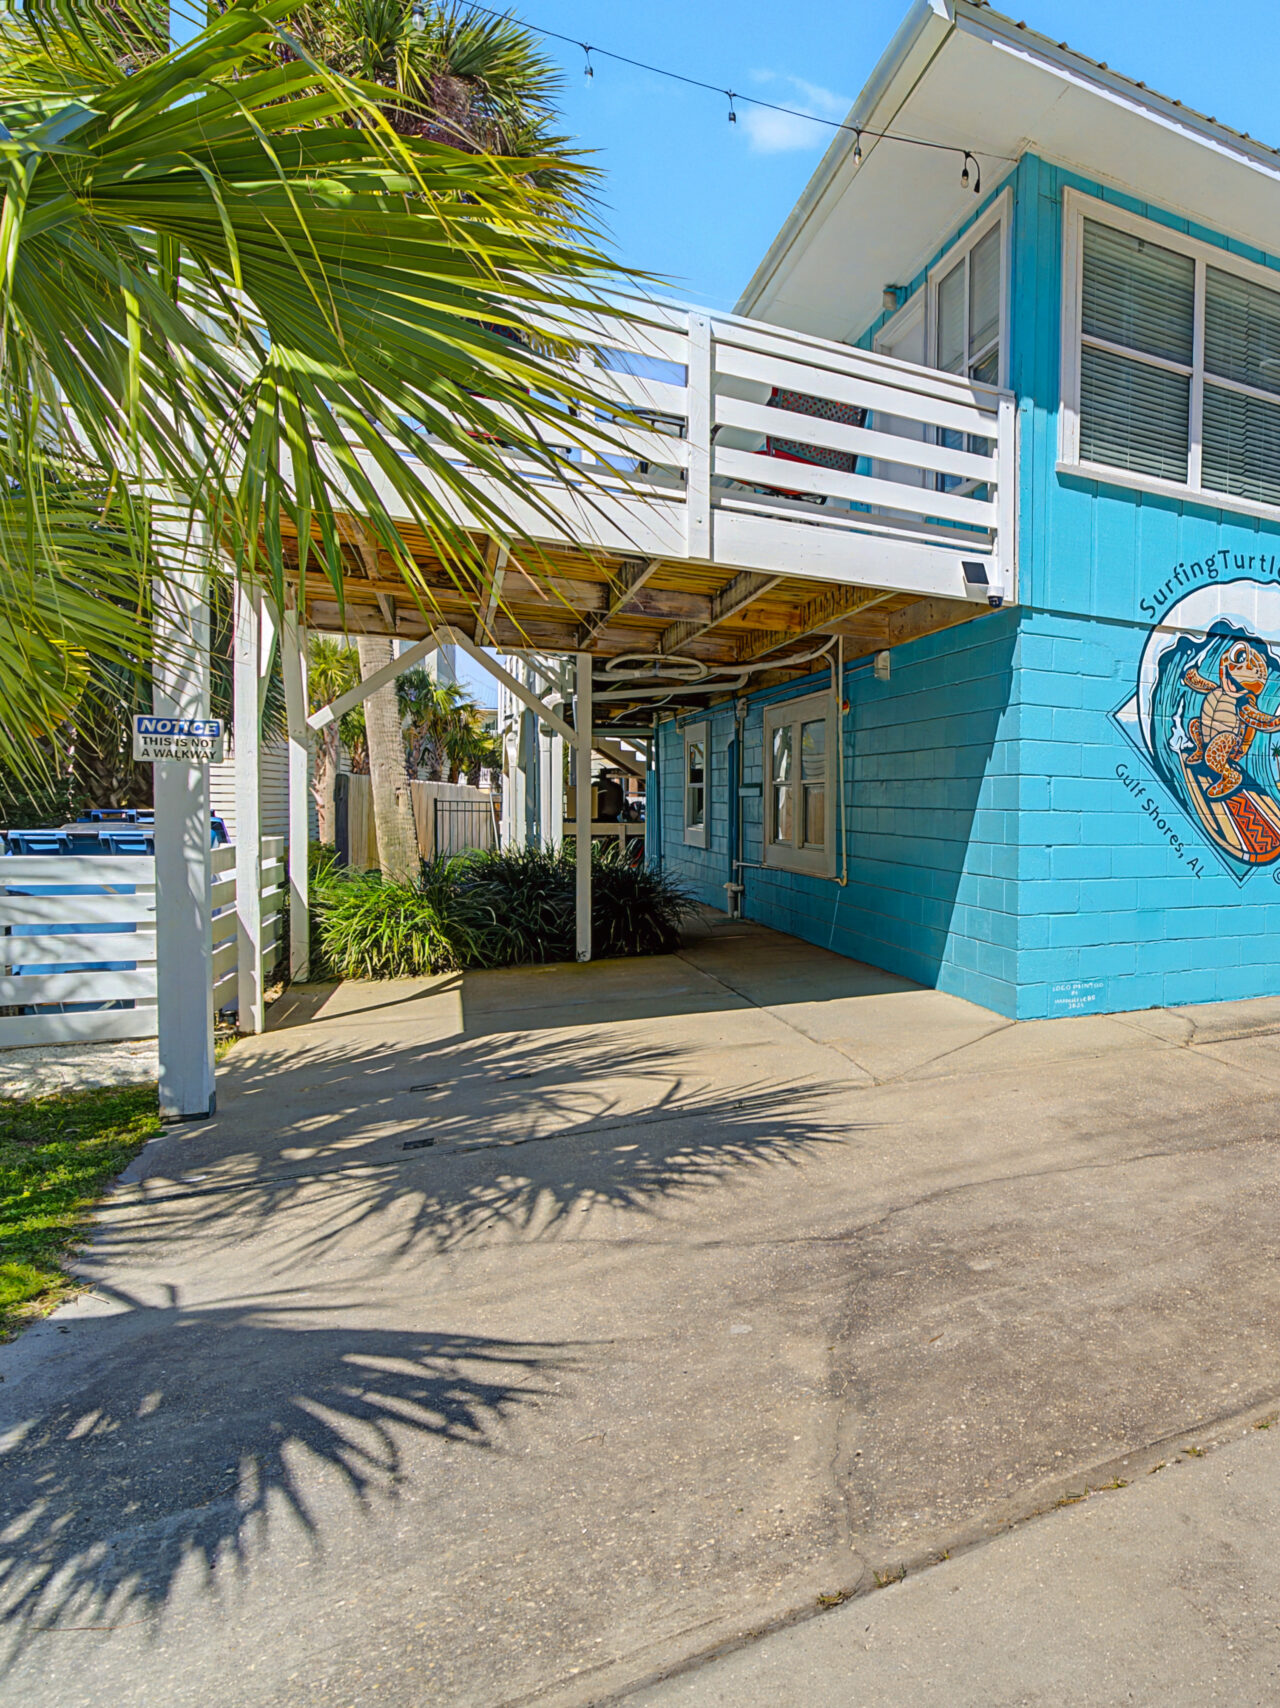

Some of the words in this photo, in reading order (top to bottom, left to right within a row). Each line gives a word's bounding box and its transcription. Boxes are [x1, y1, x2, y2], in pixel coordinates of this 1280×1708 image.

[139, 719, 218, 735] NOTICE
[142, 736, 171, 746] THIS
[175, 738, 188, 747] IS
[191, 739, 217, 748] NOT
[141, 748, 150, 757] A
[153, 748, 217, 760] WALKWAY
[1115, 763, 1147, 798] Gulf
[1141, 798, 1185, 859] Shores,
[1186, 857, 1205, 880] AL
